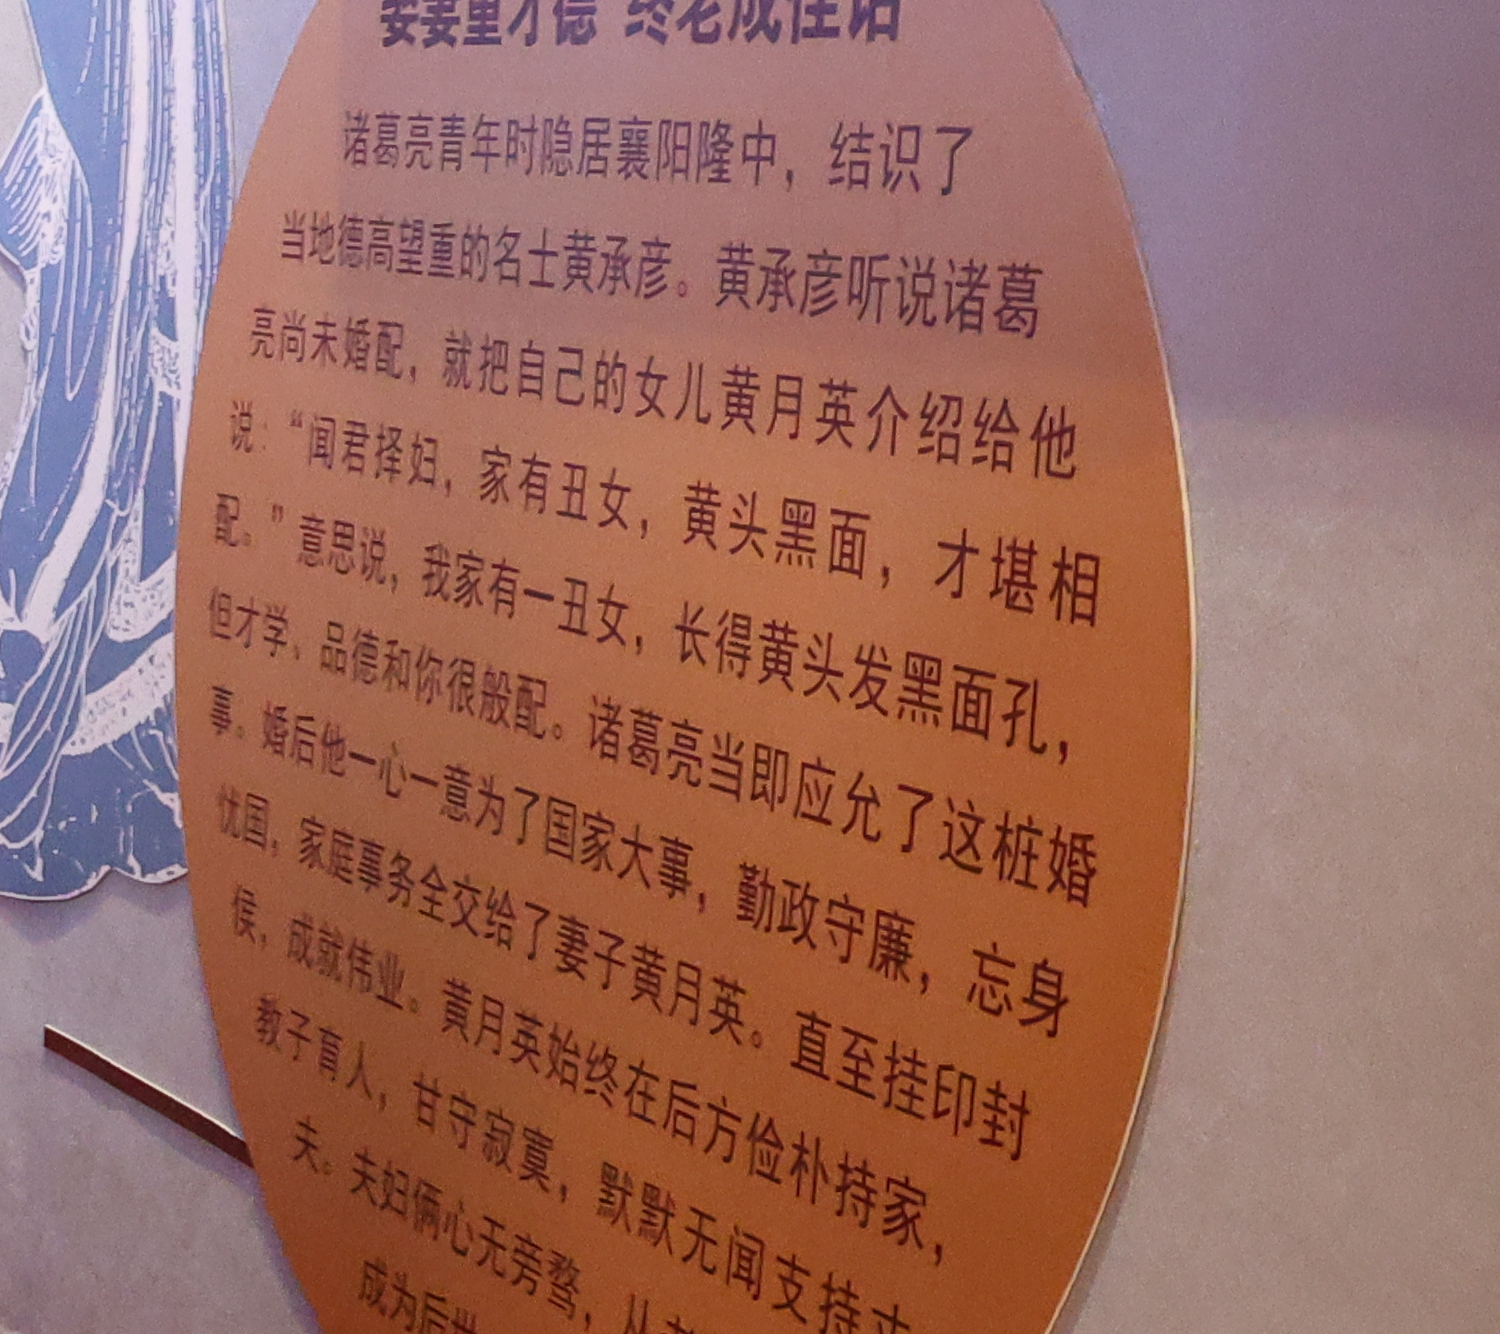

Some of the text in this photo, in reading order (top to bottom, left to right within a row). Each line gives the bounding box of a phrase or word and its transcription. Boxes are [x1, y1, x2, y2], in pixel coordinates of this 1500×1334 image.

[342, 108, 975, 196] 诸葛亮青年时隐居襄阳隆中，结识了
